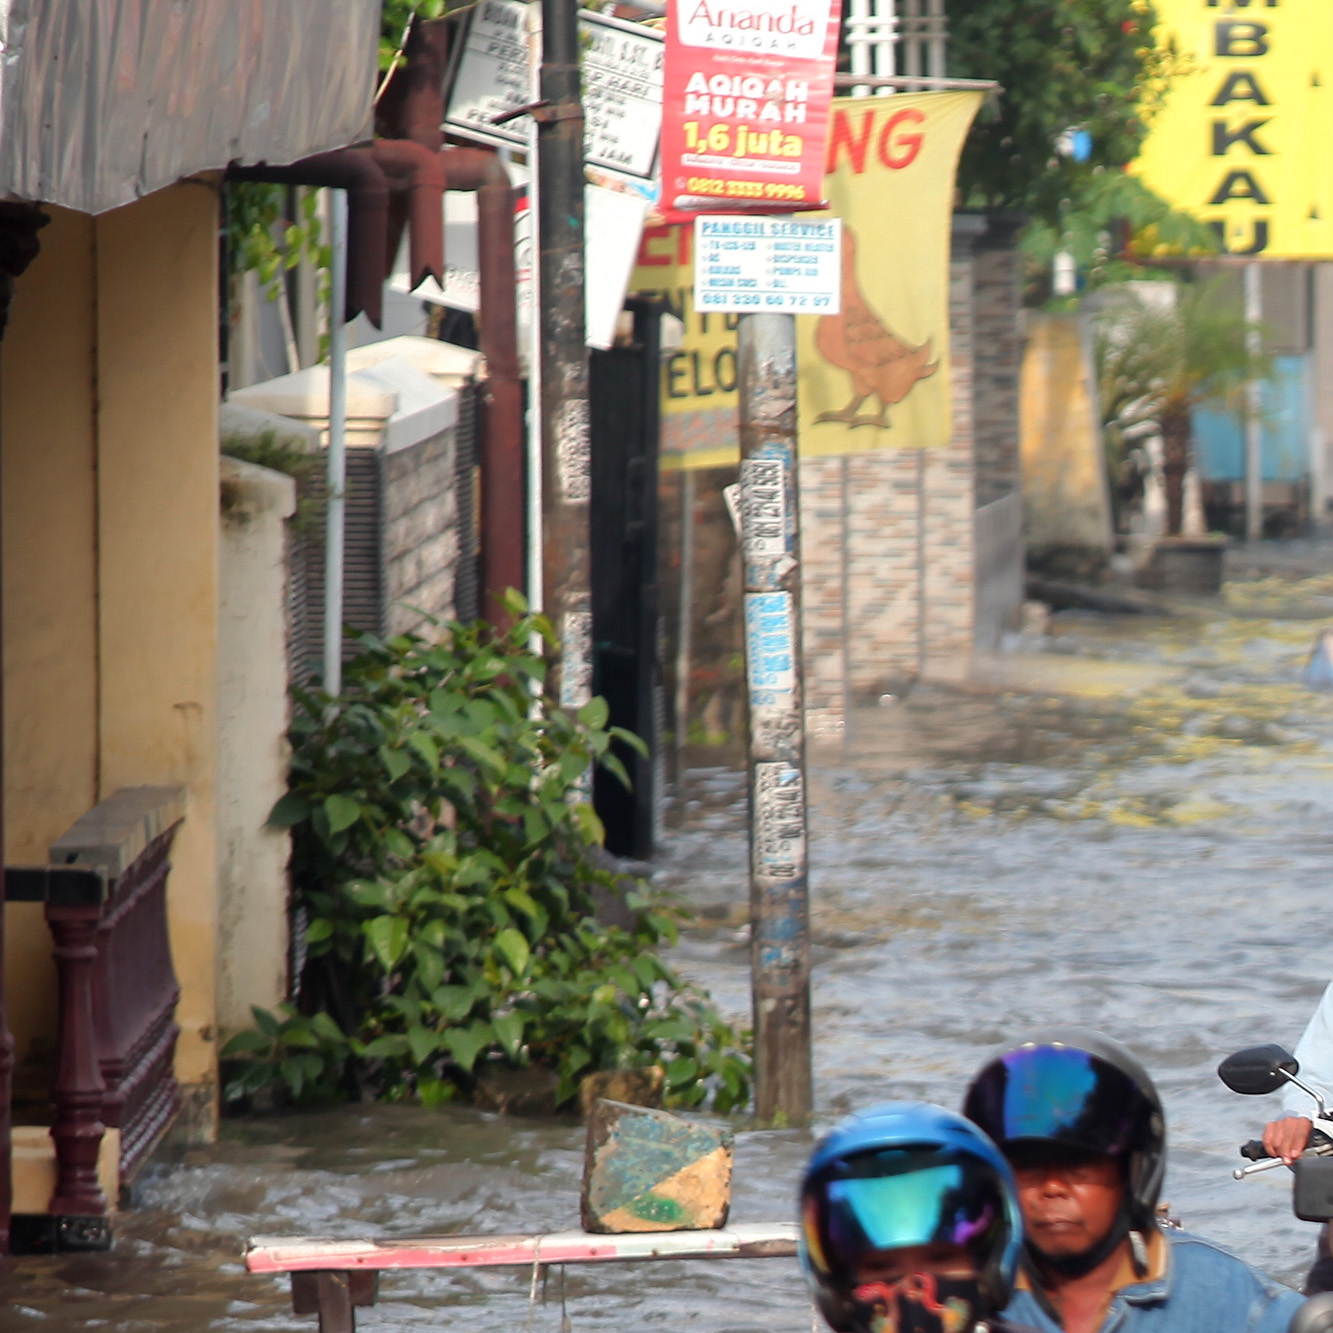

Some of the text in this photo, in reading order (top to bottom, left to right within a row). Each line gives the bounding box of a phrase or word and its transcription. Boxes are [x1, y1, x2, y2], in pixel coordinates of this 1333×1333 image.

[688, 0, 814, 36] Ananda
[705, 33, 796, 48] AQIQAH
[684, 72, 808, 102] AQIQAH
[684, 94, 807, 123] MURAH
[683, 121, 803, 158] 1,6 juta
[702, 222, 835, 237] PANGGIL SERVICE
